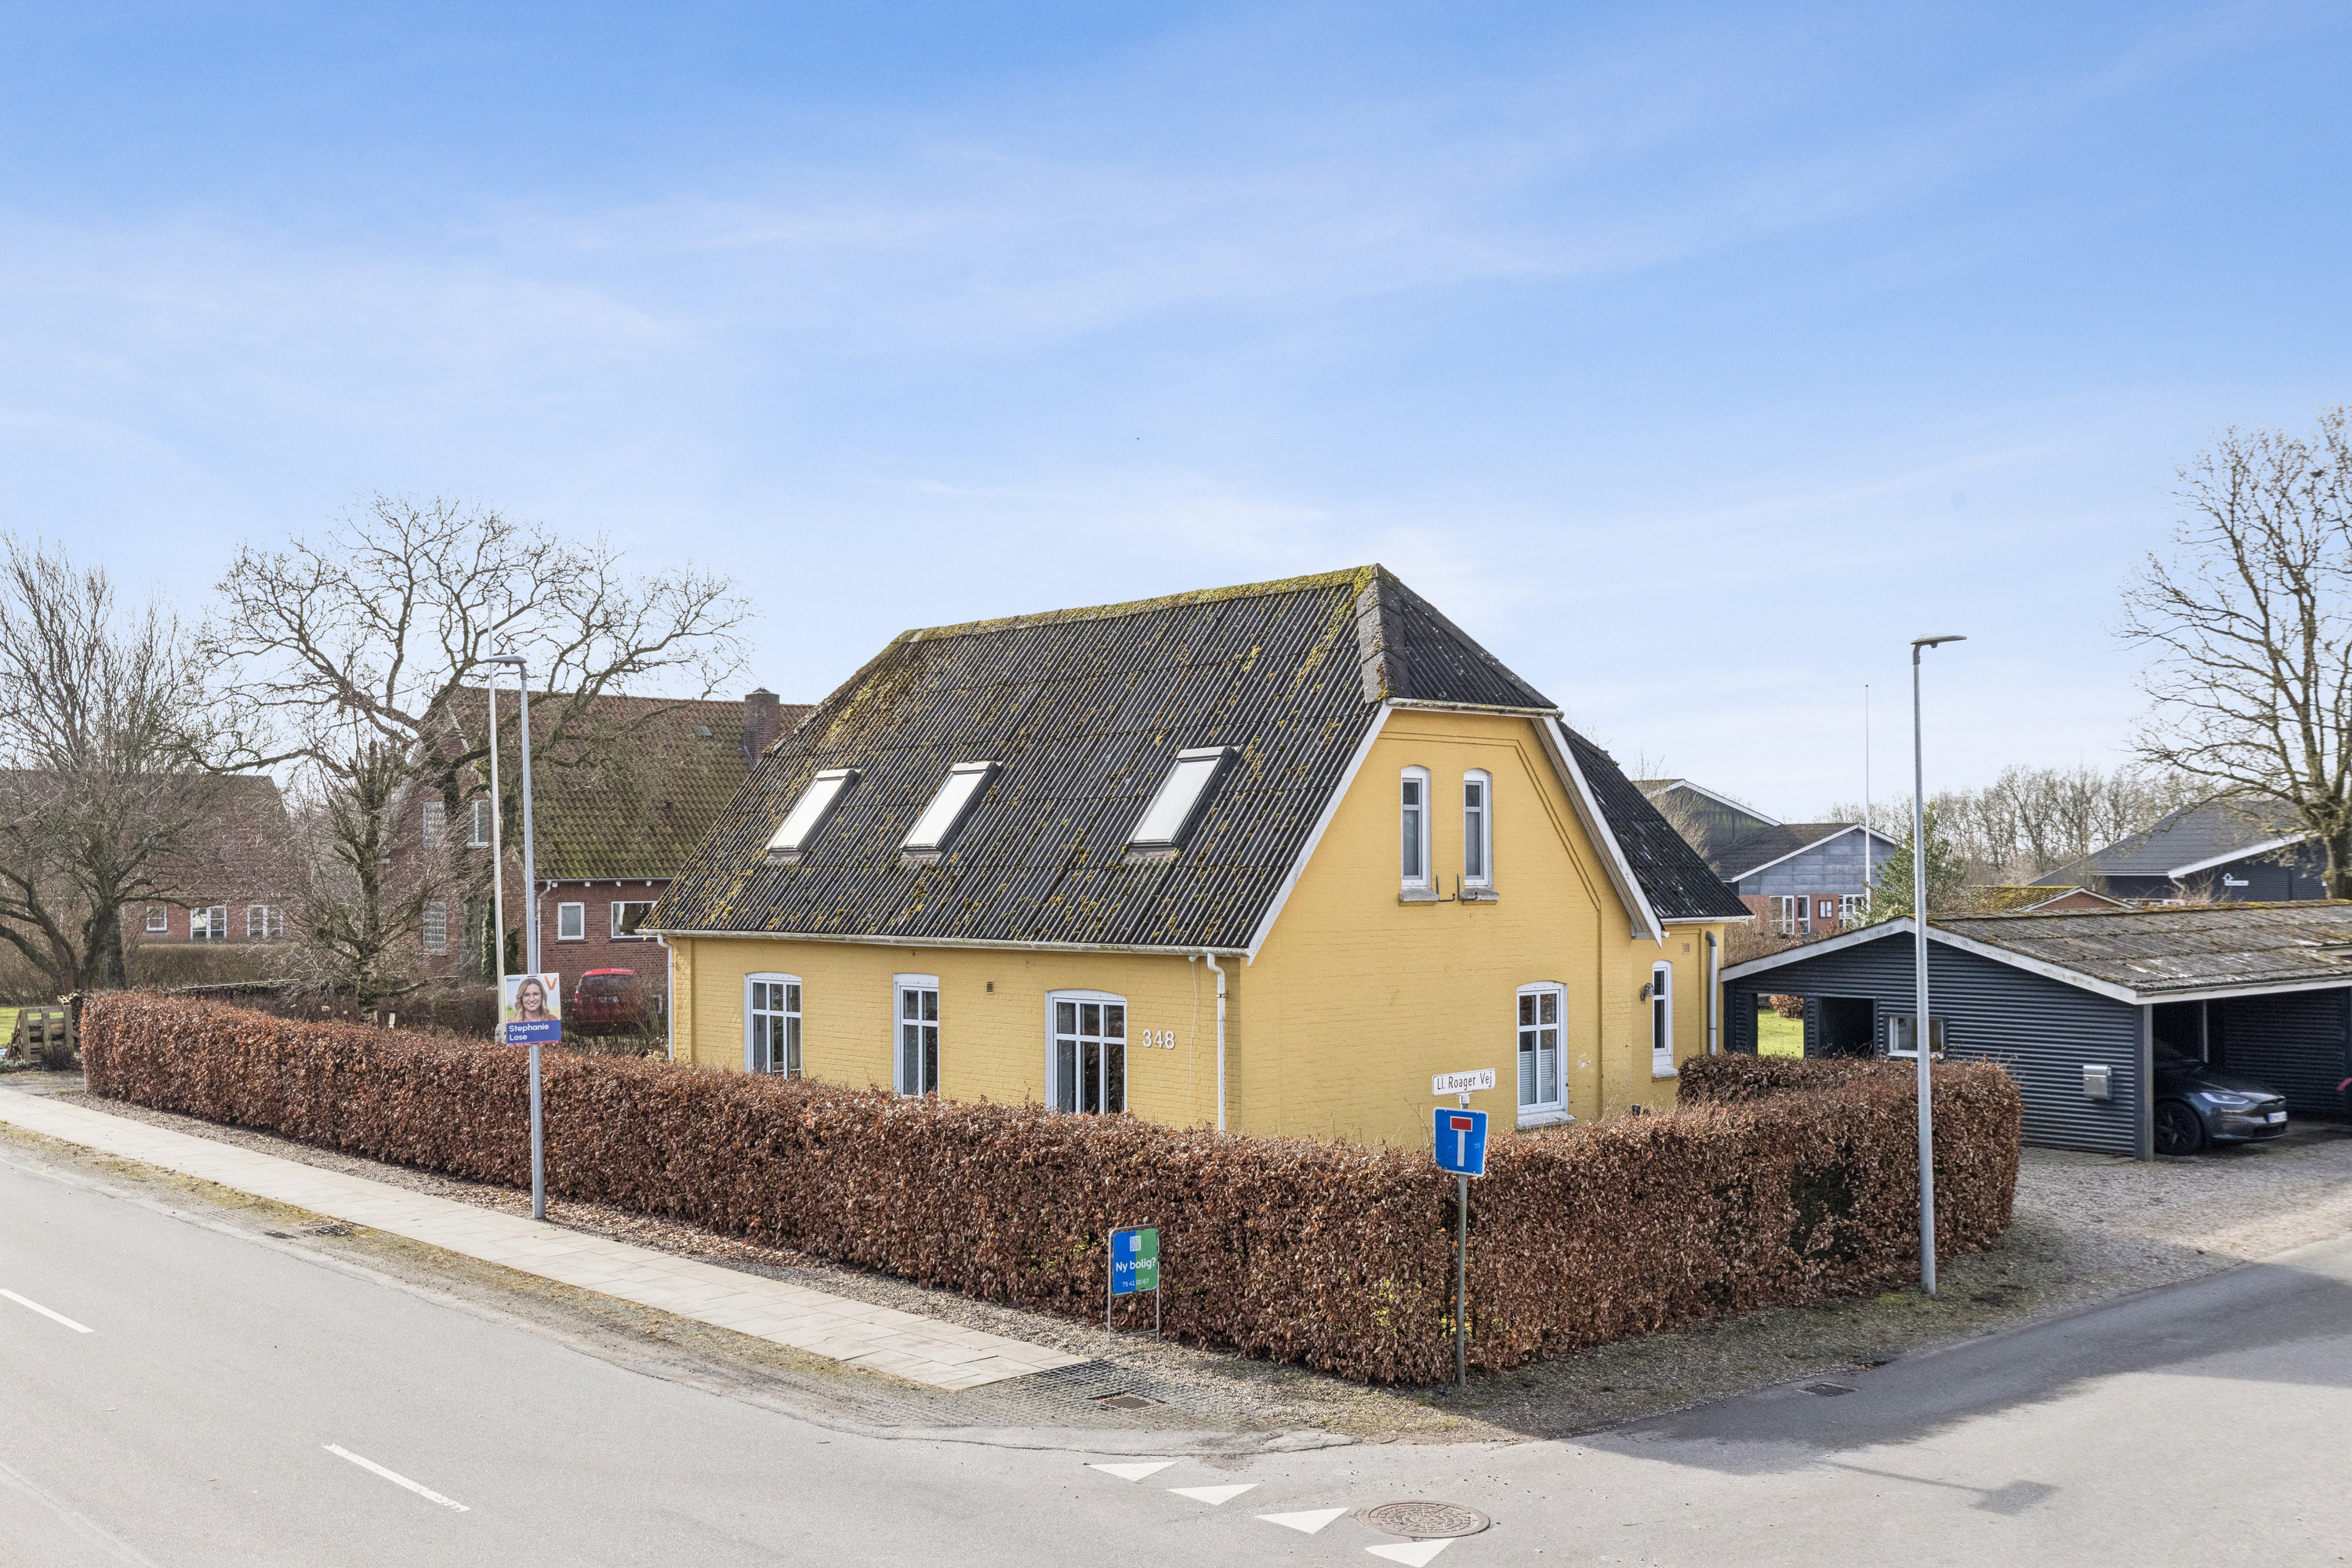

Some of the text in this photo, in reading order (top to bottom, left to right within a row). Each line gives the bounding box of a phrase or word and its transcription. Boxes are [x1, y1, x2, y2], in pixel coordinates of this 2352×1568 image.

[544, 975, 558, 990] V
[509, 1023, 550, 1033] Stephanie
[1142, 1029, 1175, 1050] 348
[1448, 1076, 1476, 1091] Roager
[1479, 1072, 1493, 1088] Vej
[1116, 1257, 1156, 1273] Ny bolig?
